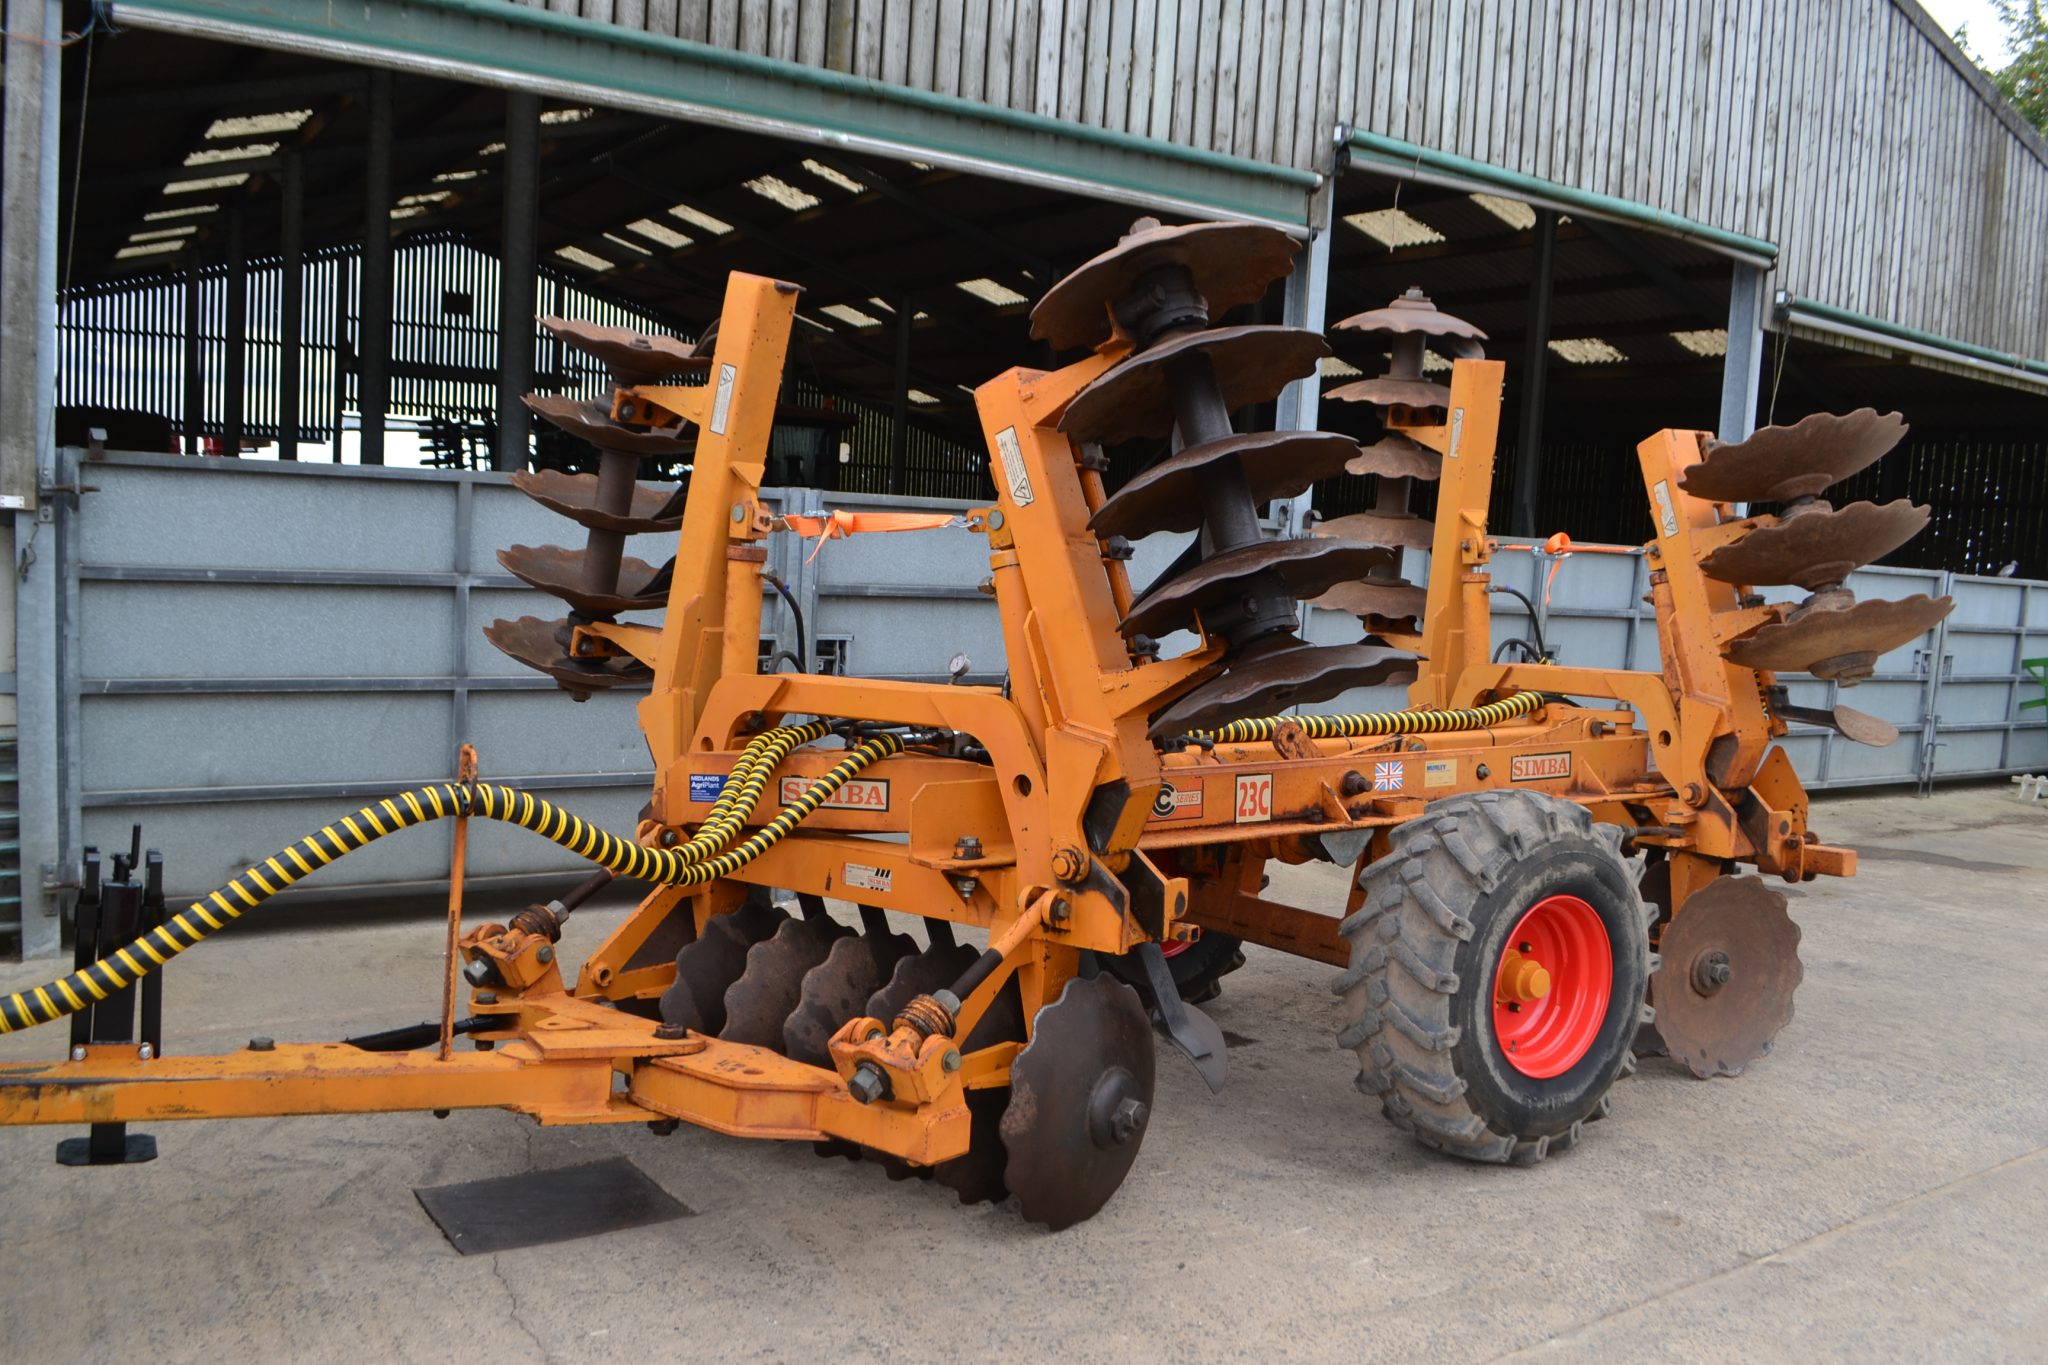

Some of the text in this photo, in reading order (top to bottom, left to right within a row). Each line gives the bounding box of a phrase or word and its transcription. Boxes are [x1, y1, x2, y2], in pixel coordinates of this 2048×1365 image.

[1513, 757, 1568, 777] SIMBA
[691, 781, 720, 790] AgriPlant
[1176, 792, 1200, 804] SERIES
[1238, 780, 1270, 817] 23C
